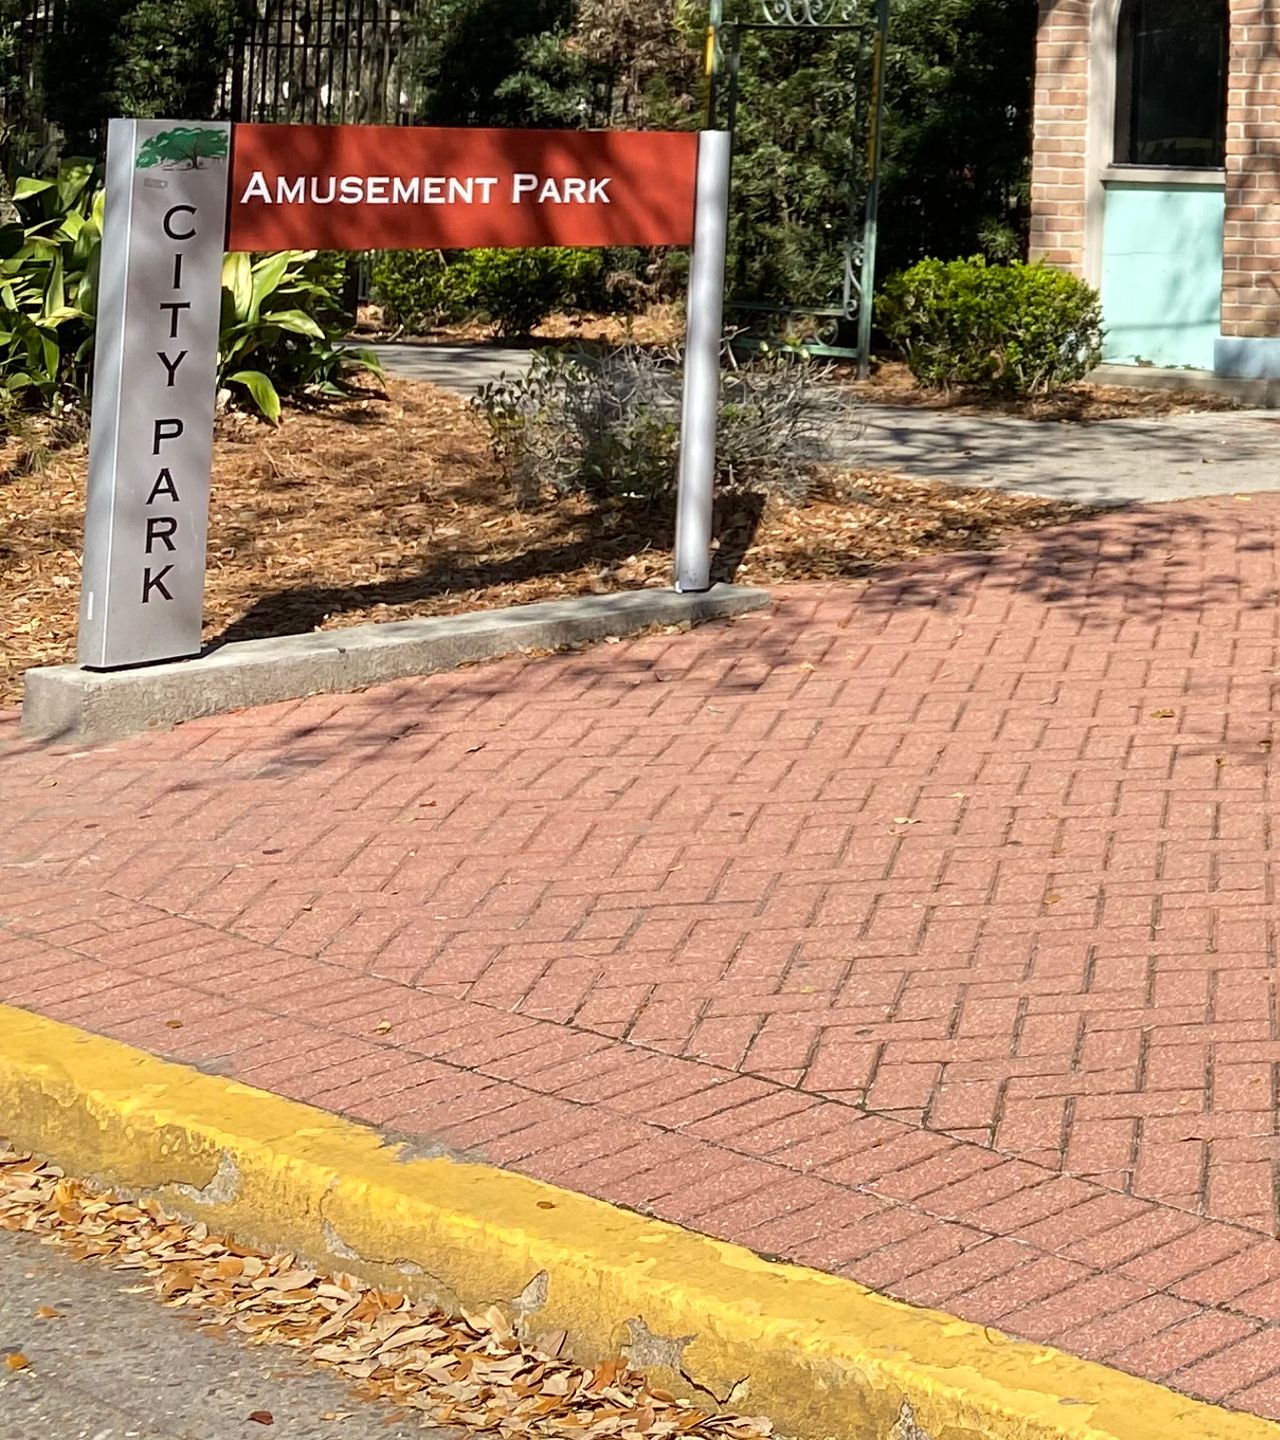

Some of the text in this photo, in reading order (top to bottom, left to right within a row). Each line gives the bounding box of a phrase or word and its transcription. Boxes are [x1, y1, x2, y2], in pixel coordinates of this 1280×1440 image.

[239, 170, 612, 205] AMUSEMENT PARK
[140, 203, 197, 604] CITY PARK
